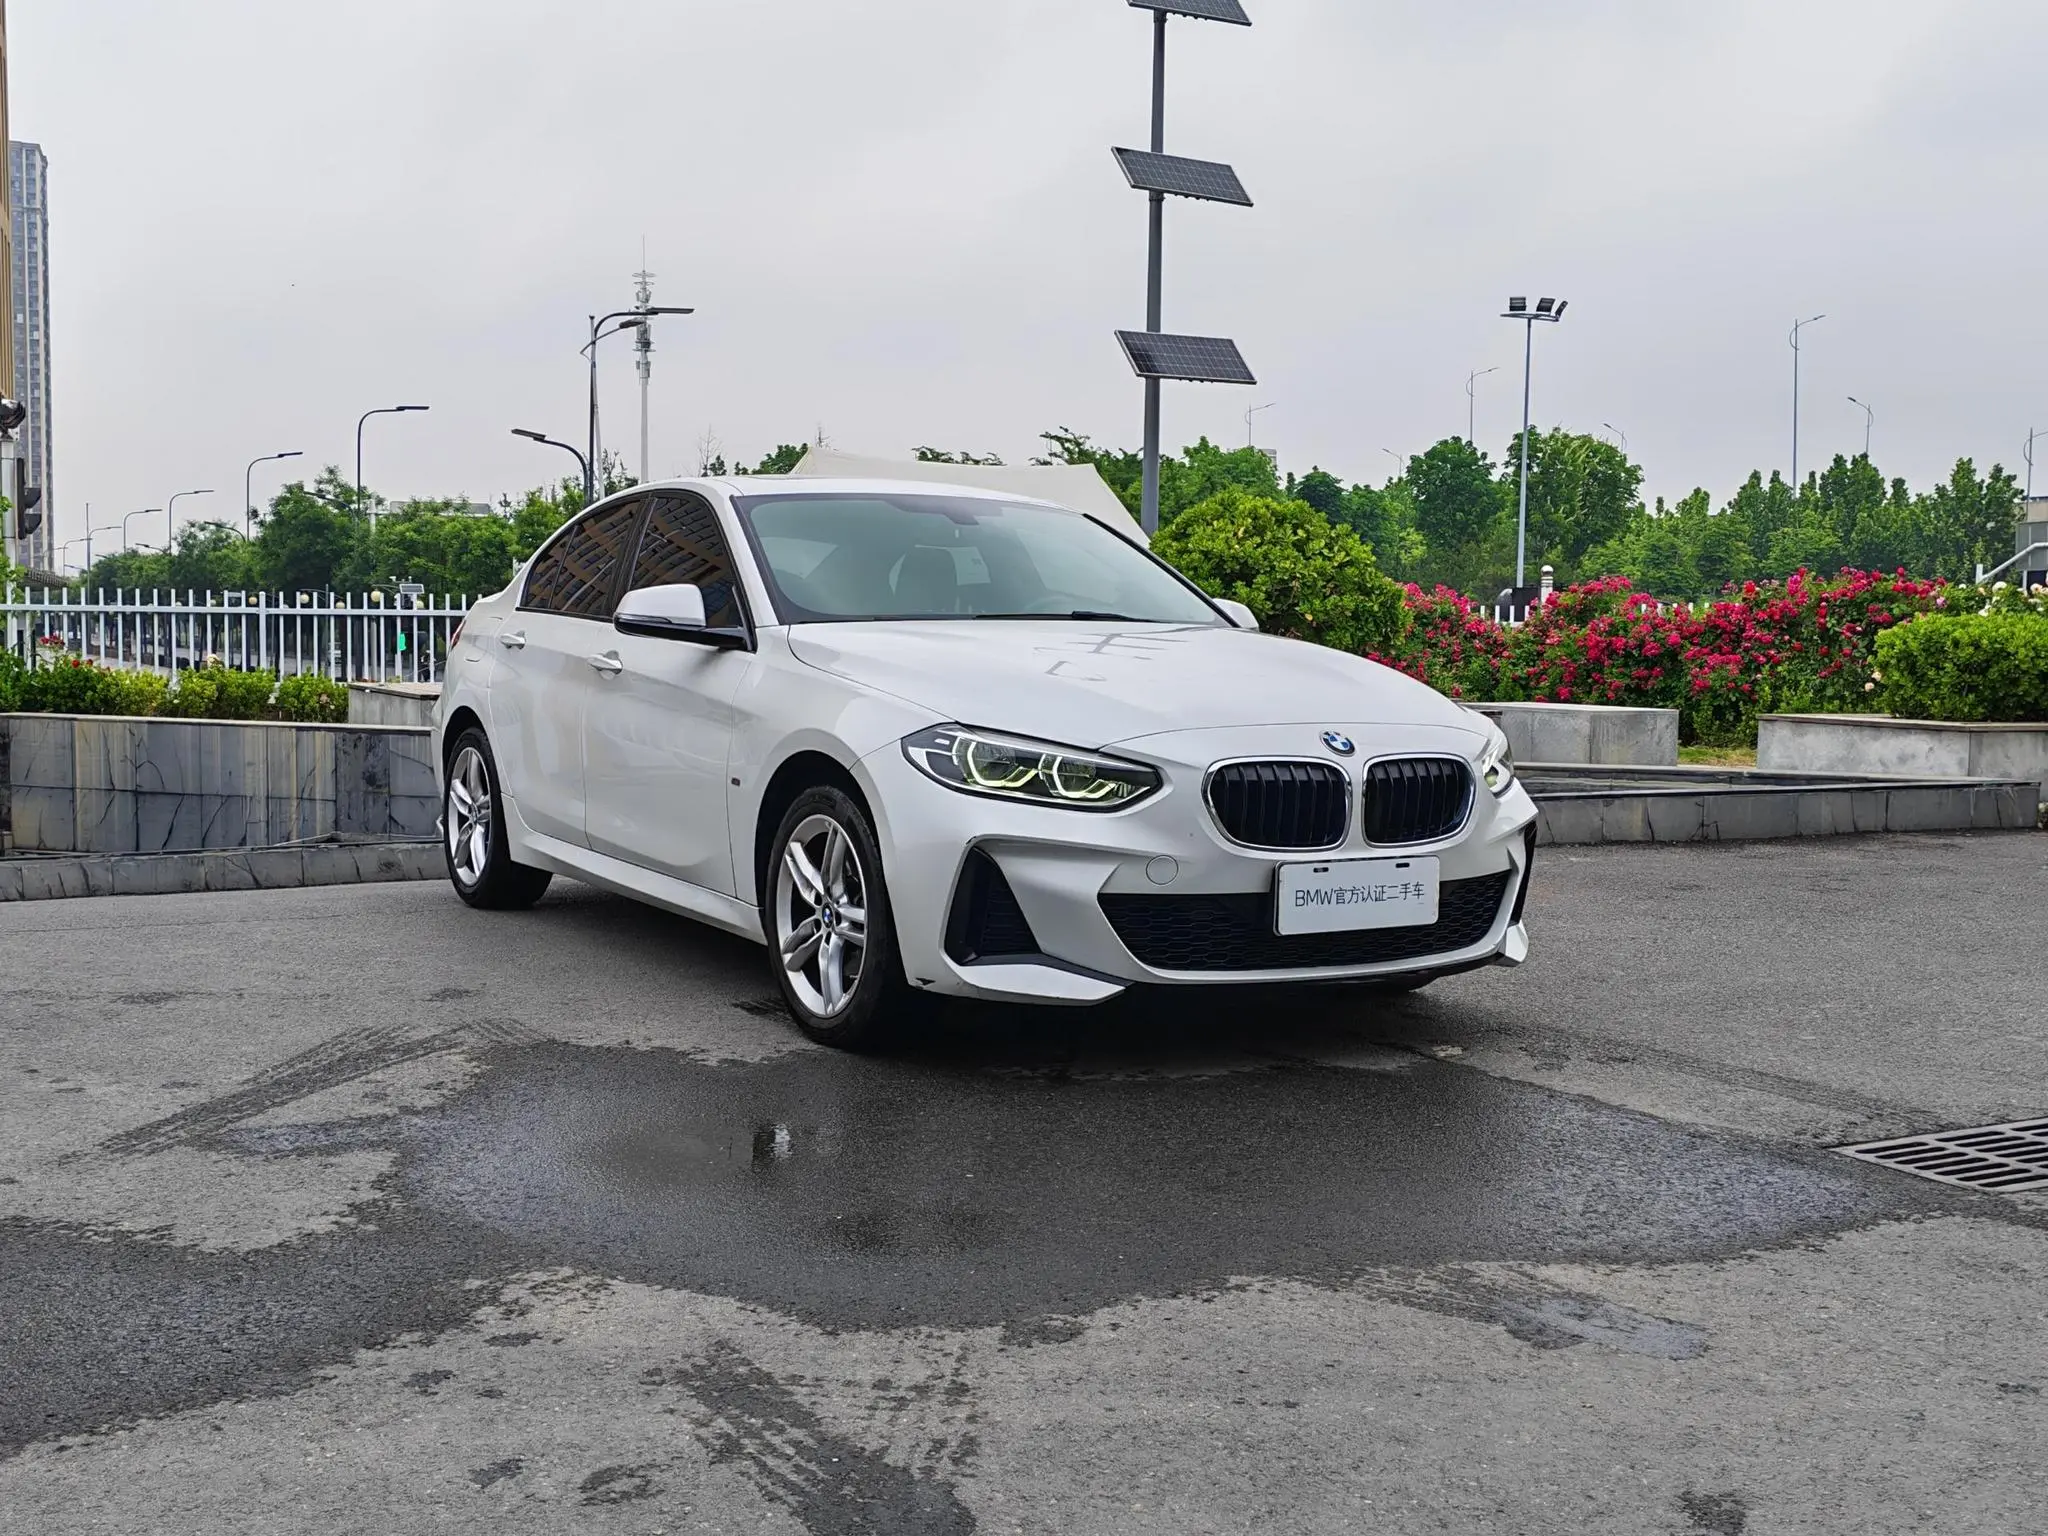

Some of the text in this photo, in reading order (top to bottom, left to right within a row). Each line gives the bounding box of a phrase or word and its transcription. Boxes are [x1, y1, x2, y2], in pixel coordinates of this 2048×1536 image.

[1295, 881, 1425, 907] BMW官方认证二手车
